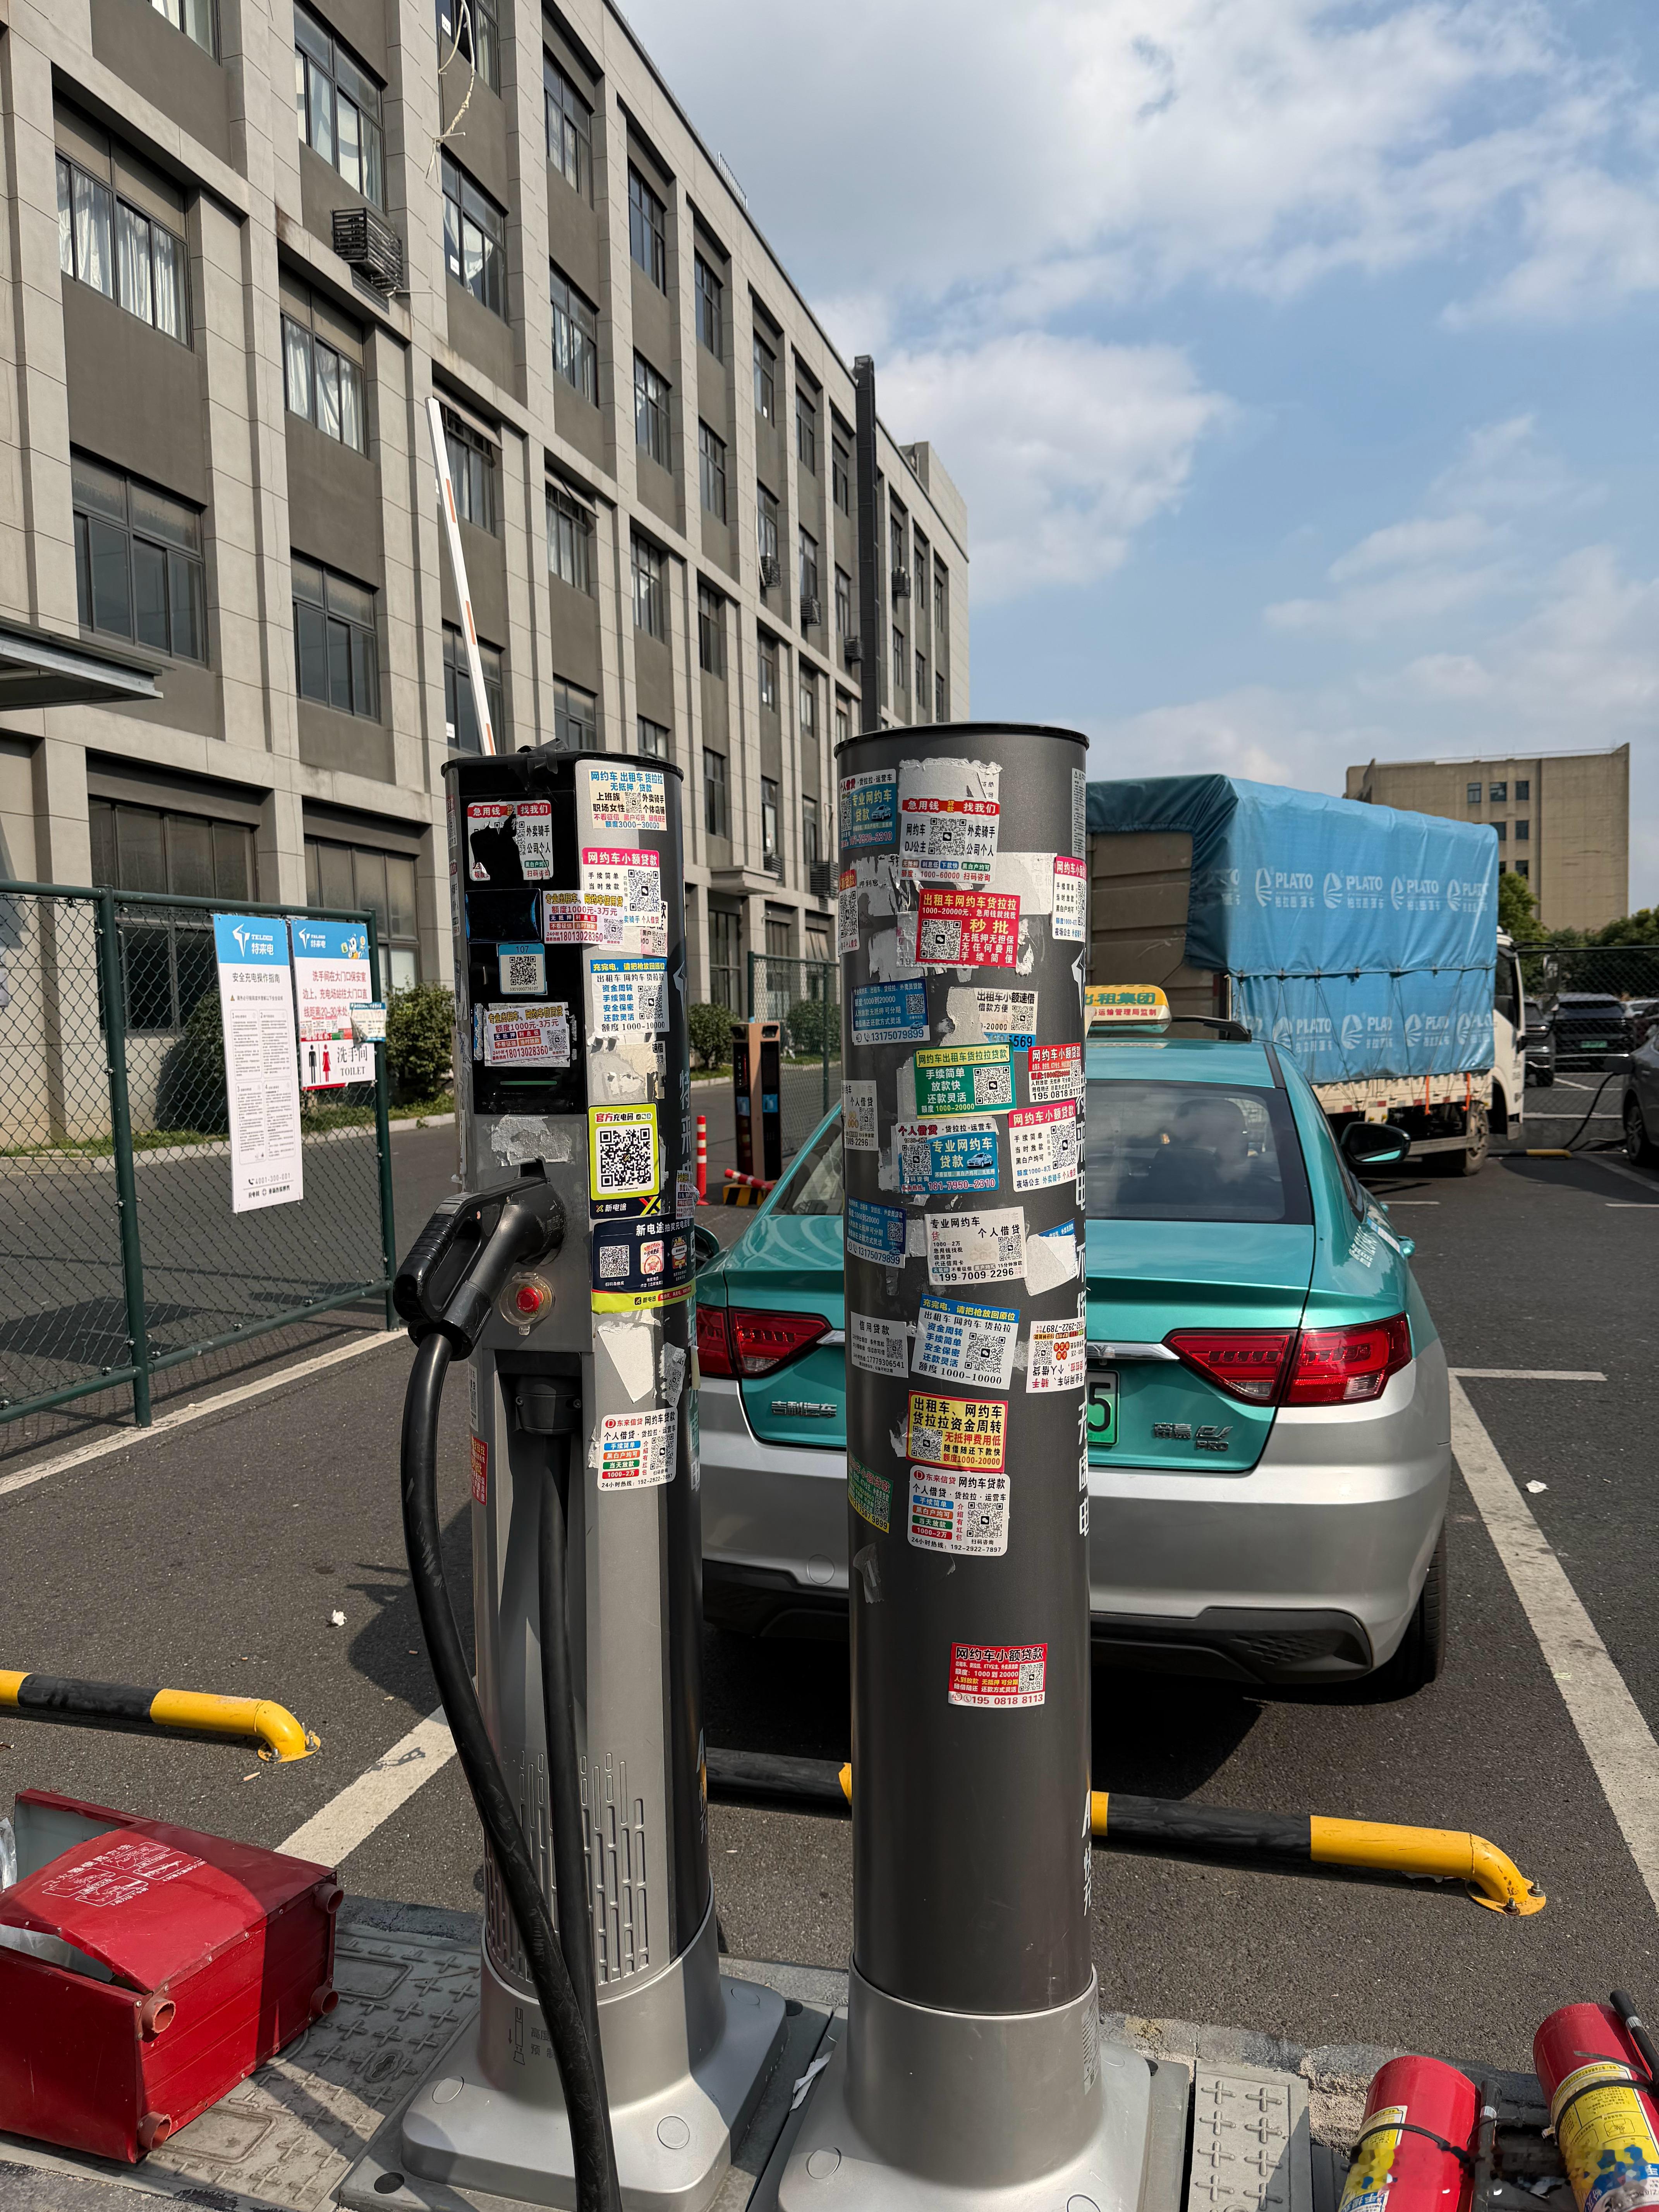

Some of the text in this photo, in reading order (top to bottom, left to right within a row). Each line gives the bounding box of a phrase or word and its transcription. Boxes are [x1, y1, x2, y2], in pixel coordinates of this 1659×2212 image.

[591, 771, 663, 784] 网约车 出租车 货拉拉
[610, 782, 652, 792] 无抵押 贷款
[596, 792, 620, 801] 上班族
[642, 793, 664, 803] 外卖骑手
[852, 789, 892, 806] 专业网约车
[473, 807, 500, 816] 急用钱
[520, 805, 548, 814] 找我们
[593, 804, 625, 812] 职场女性
[643, 804, 665, 814] 个体店铺
[907, 800, 996, 813] 急用钱 找我们
[856, 807, 869, 822] 贷款
[526, 825, 550, 837] 外卖骑手
[906, 823, 926, 836] 网约车
[967, 824, 995, 838] 外卖骑手
[527, 842, 550, 854] 公司个人
[905, 841, 926, 852] DJ公主
[967, 843, 994, 857] 公司个人
[588, 852, 657, 866] 网约车小额贷款
[963, 872, 991, 882] 扫码咨询
[1276, 873, 1313, 890] PLATO
[1346, 876, 1382, 891] PLATO
[1407, 880, 1439, 894] PLATO
[924, 894, 1017, 910] 出租车网约车货拉拉
[551, 906, 617, 916] 额度1000元-3万元
[642, 915, 659, 924] 个人借贷
[560, 931, 603, 942] 18013028360
[962, 933, 1014, 944] 无抵押无担保
[252, 943, 274, 955] 特来电
[311, 940, 326, 948] 特来电
[961, 942, 1013, 954] 无任何费用
[960, 951, 1013, 963] 手续简便
[232, 972, 280, 983] 安全充电操作指南
[312, 970, 367, 982] 洗手间在大门口保安室
[977, 991, 1035, 1004] 出租车小额速借
[979, 1003, 1008, 1013] 借款方便
[604, 1014, 634, 1022] 还款灵活
[495, 1019, 559, 1033] 额度1000元-3万元
[602, 1022, 665, 1032] 额度 1000-10000
[871, 1029, 924, 1041] 13175079899
[337, 1045, 368, 1063] 洗手间
[505, 1045, 548, 1059] 18013028360
[918, 1049, 1007, 1064] 网约车出租车货拉拉贷款
[1032, 1046, 1080, 1062] 网约车小额贷款
[340, 1066, 365, 1077] TOILET
[926, 1068, 965, 1080] 手续简单
[931, 1080, 961, 1091] 放款快
[927, 1092, 967, 1104] 还款灵活
[1051, 1090, 1068, 1098] 0818
[1069, 1087, 1080, 1096] 8113
[850, 1097, 873, 1107] 个人借贷
[936, 1103, 974, 1112] 1000-20000
[596, 1113, 634, 1122] 官方充电码
[1013, 1105, 1074, 1126] 网约车小额贷款
[898, 1125, 938, 1136] 个人借贷
[1014, 1132, 1042, 1142] 手续简单
[932, 1137, 993, 1153] 专业网约车
[1015, 1143, 1043, 1153] 当时放款
[940, 1155, 963, 1168] 贷款
[1016, 1154, 1044, 1164] 黑白户均可
[1017, 1168, 1076, 1188] 夜场公主 外卖骑手 个人借贷
[928, 1178, 996, 1191] 181-7950-2310
[605, 1203, 627, 1212] 新电途
[930, 1217, 980, 1229] 专业网约车
[978, 1224, 1020, 1238] 个人借贷
[858, 1247, 900, 1264] 13175079899
[939, 1268, 1014, 1281] 199-7009-2296
[859, 1320, 890, 1335] 信用贷款
[924, 1311, 1011, 1333] 出租车 网约车 货拉拉
[928, 1322, 963, 1336] 资金周转
[926, 1332, 962, 1346] 手续简单
[924, 1343, 960, 1357] 安全保密
[923, 1353, 958, 1367] 还款灵活
[919, 1361, 1002, 1384] 额度 1000-10000
[1033, 1365, 1064, 1376] 个人借贷
[1032, 1378, 1049, 1388] 骑手
[771, 1401, 837, 1417] 吉利汽车
[617, 1412, 675, 1427] 东来信贷 网约车贷款
[913, 1411, 1001, 1434] 货拉拉资金周转
[604, 1430, 635, 1441] 个人借贷
[945, 1432, 1001, 1446] 无抵押费用低
[1196, 1441, 1229, 1451] PRO
[610, 1460, 634, 1468] 当天放款
[943, 1453, 1000, 1465] 额度1000-20000
[926, 1474, 1005, 1489] 东来信贷 网约车贷款
[913, 1483, 977, 1500] 个人借贷 货拉拉
[920, 1497, 947, 1507] 手续简单
[916, 1507, 950, 1518] 黑白户均可
[919, 1518, 946, 1528] 当天放款
[956, 1503, 964, 1541] 介绍有红包
[917, 1527, 947, 1538] 1000-2万
[956, 1647, 1044, 1662] 网约车小额贷款
[954, 1676, 979, 1684] 人到放款
[972, 1696, 989, 1704] 195
[1022, 1694, 1043, 1704] 8113
